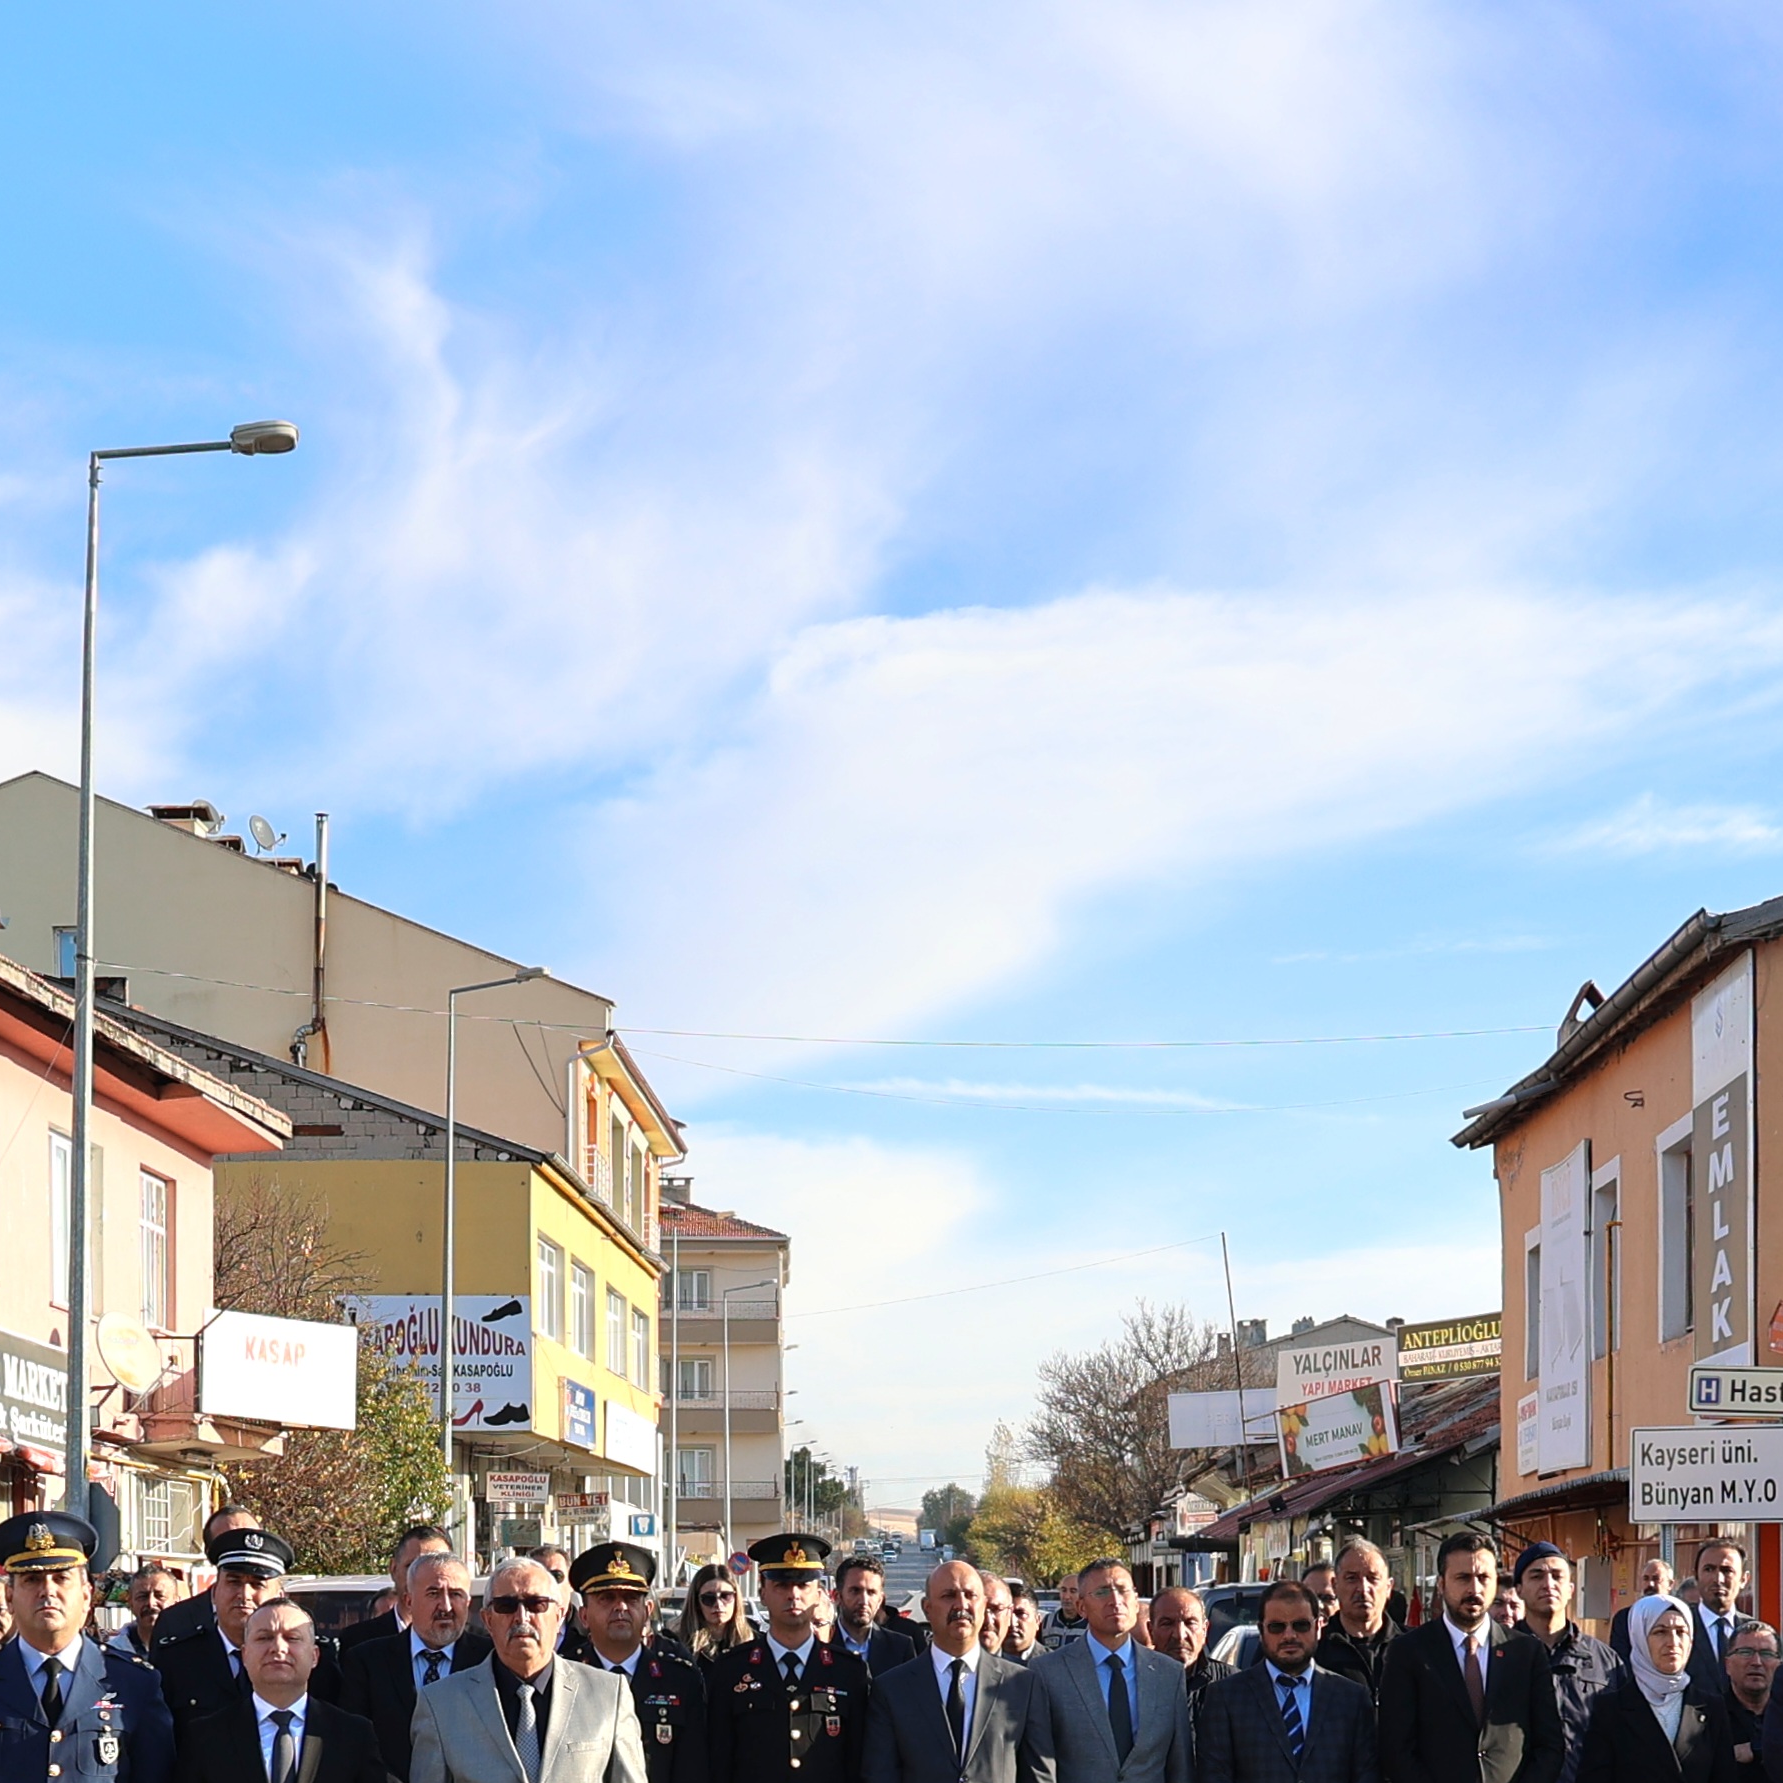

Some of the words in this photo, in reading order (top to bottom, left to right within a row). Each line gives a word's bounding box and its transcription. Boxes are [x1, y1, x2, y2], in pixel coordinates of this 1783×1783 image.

[1708, 1091, 1734, 1343] EMLAK
[1402, 1320, 1502, 1350] ANTEPLİOĞLU
[244, 1335, 306, 1367] KASAP
[1293, 1345, 1382, 1378] YALÇINLAR
[453, 1362, 514, 1377] KASAPOĞLU
[465, 1383, 481, 1393] 38
[1302, 1382, 1325, 1397] YAPI
[1328, 1376, 1373, 1394] MARKET
[1305, 1430, 1330, 1448] MERT
[1332, 1422, 1363, 1442] MANAV
[1641, 1441, 1715, 1471] Kayseri
[1722, 1439, 1758, 1464] üni.
[489, 1474, 547, 1484] KASAPOĞLU
[1641, 1482, 1714, 1510] Bünyan
[1721, 1479, 1776, 1503] M.Y.O
